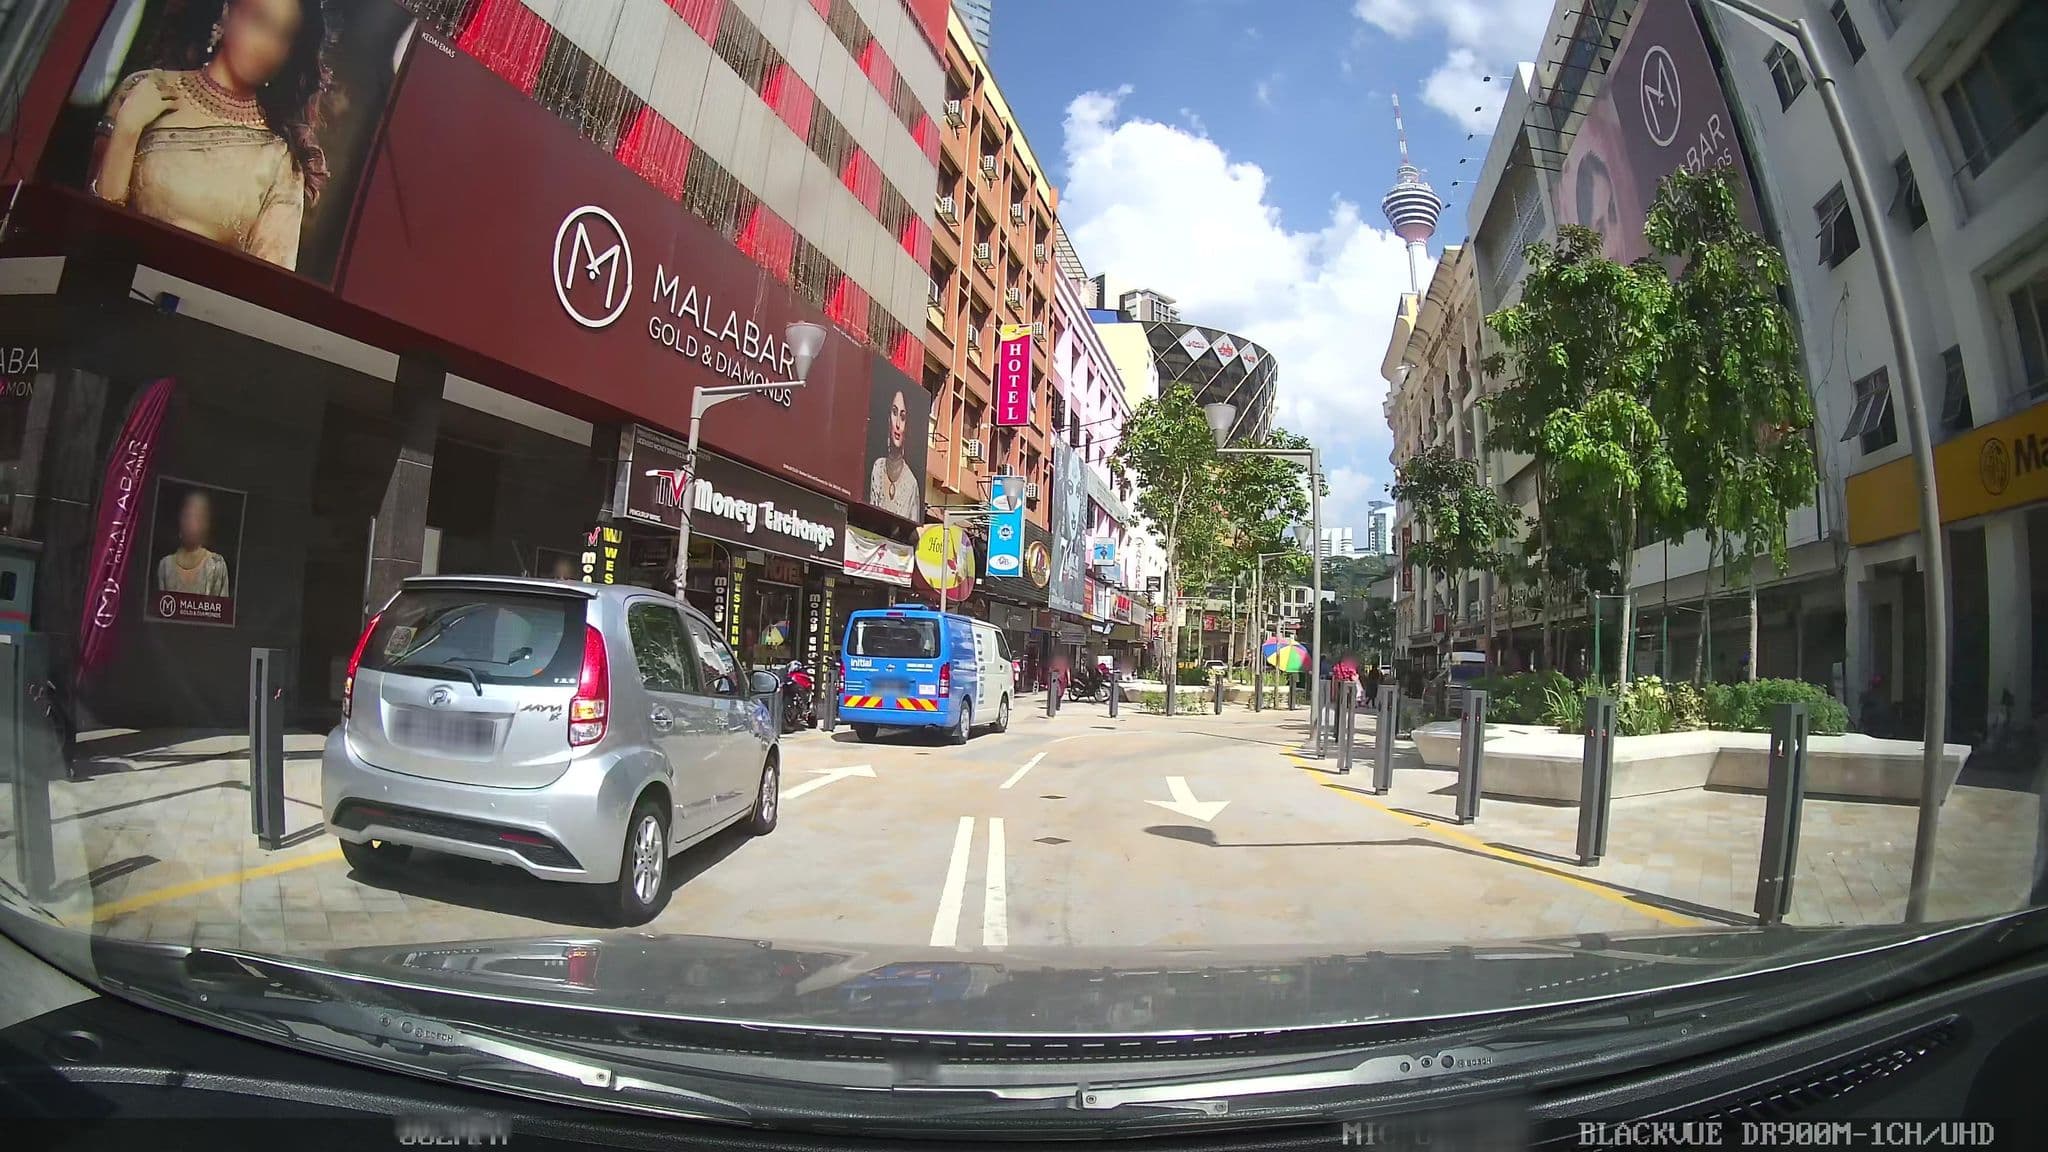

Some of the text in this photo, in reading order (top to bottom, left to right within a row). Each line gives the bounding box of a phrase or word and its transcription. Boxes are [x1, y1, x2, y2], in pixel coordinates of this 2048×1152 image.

[652, 264, 796, 381] MALABAR
[649, 316, 792, 407] GOLD & DIAMONDS
[1007, 343, 1023, 421] HOTEL
[694, 478, 757, 533] Money
[759, 501, 834, 552] Exchange
[180, 600, 222, 613] MALABAR
[731, 572, 743, 645] WESTERN
